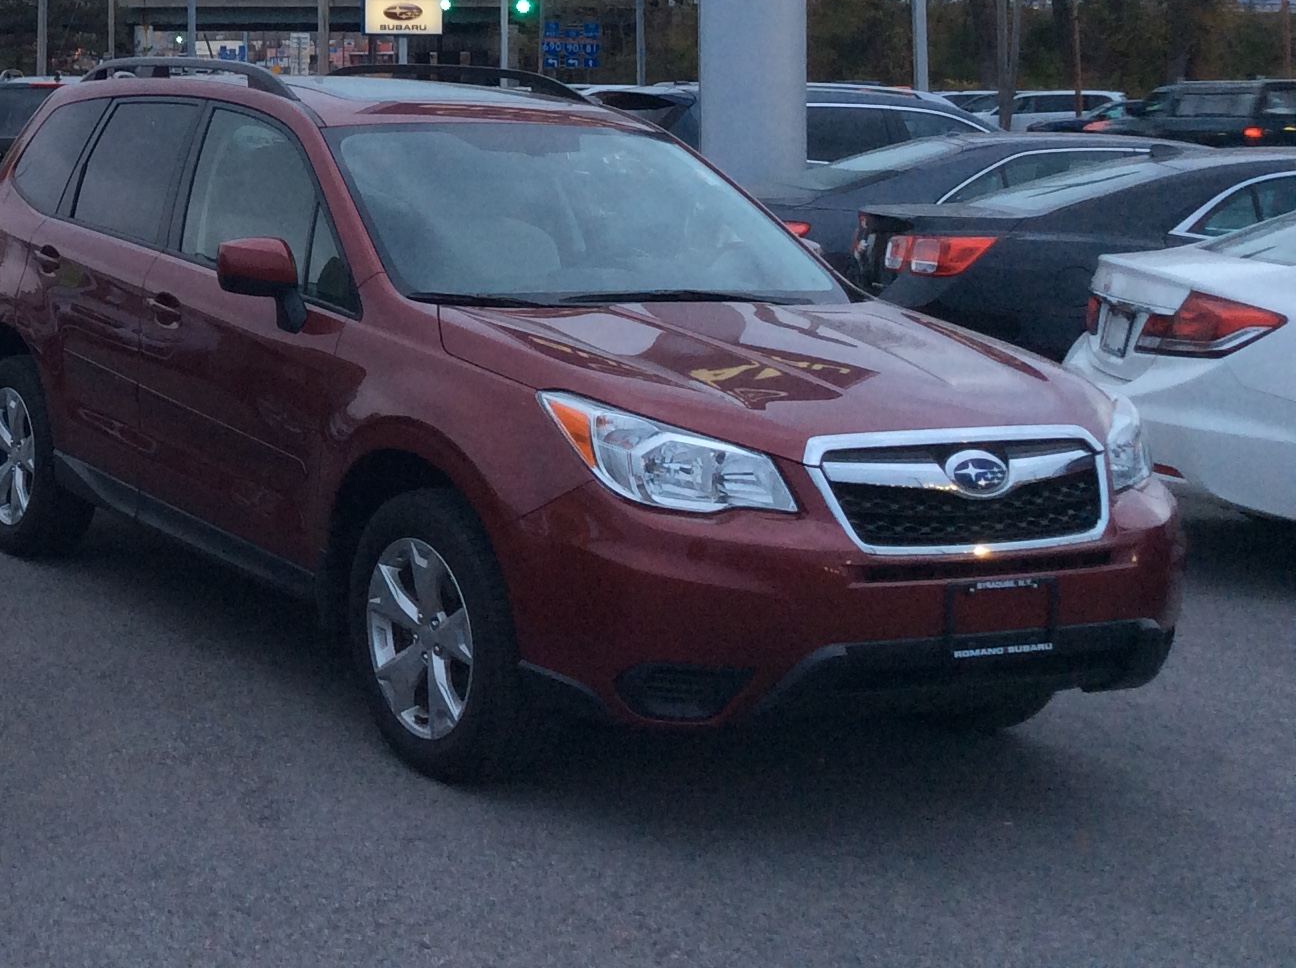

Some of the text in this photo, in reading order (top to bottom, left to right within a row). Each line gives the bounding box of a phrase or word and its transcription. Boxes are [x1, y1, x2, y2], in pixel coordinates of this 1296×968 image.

[542, 41, 562, 52] 690
[566, 43, 579, 53] 90
[953, 642, 1053, 659] ROMANO SUBARU
